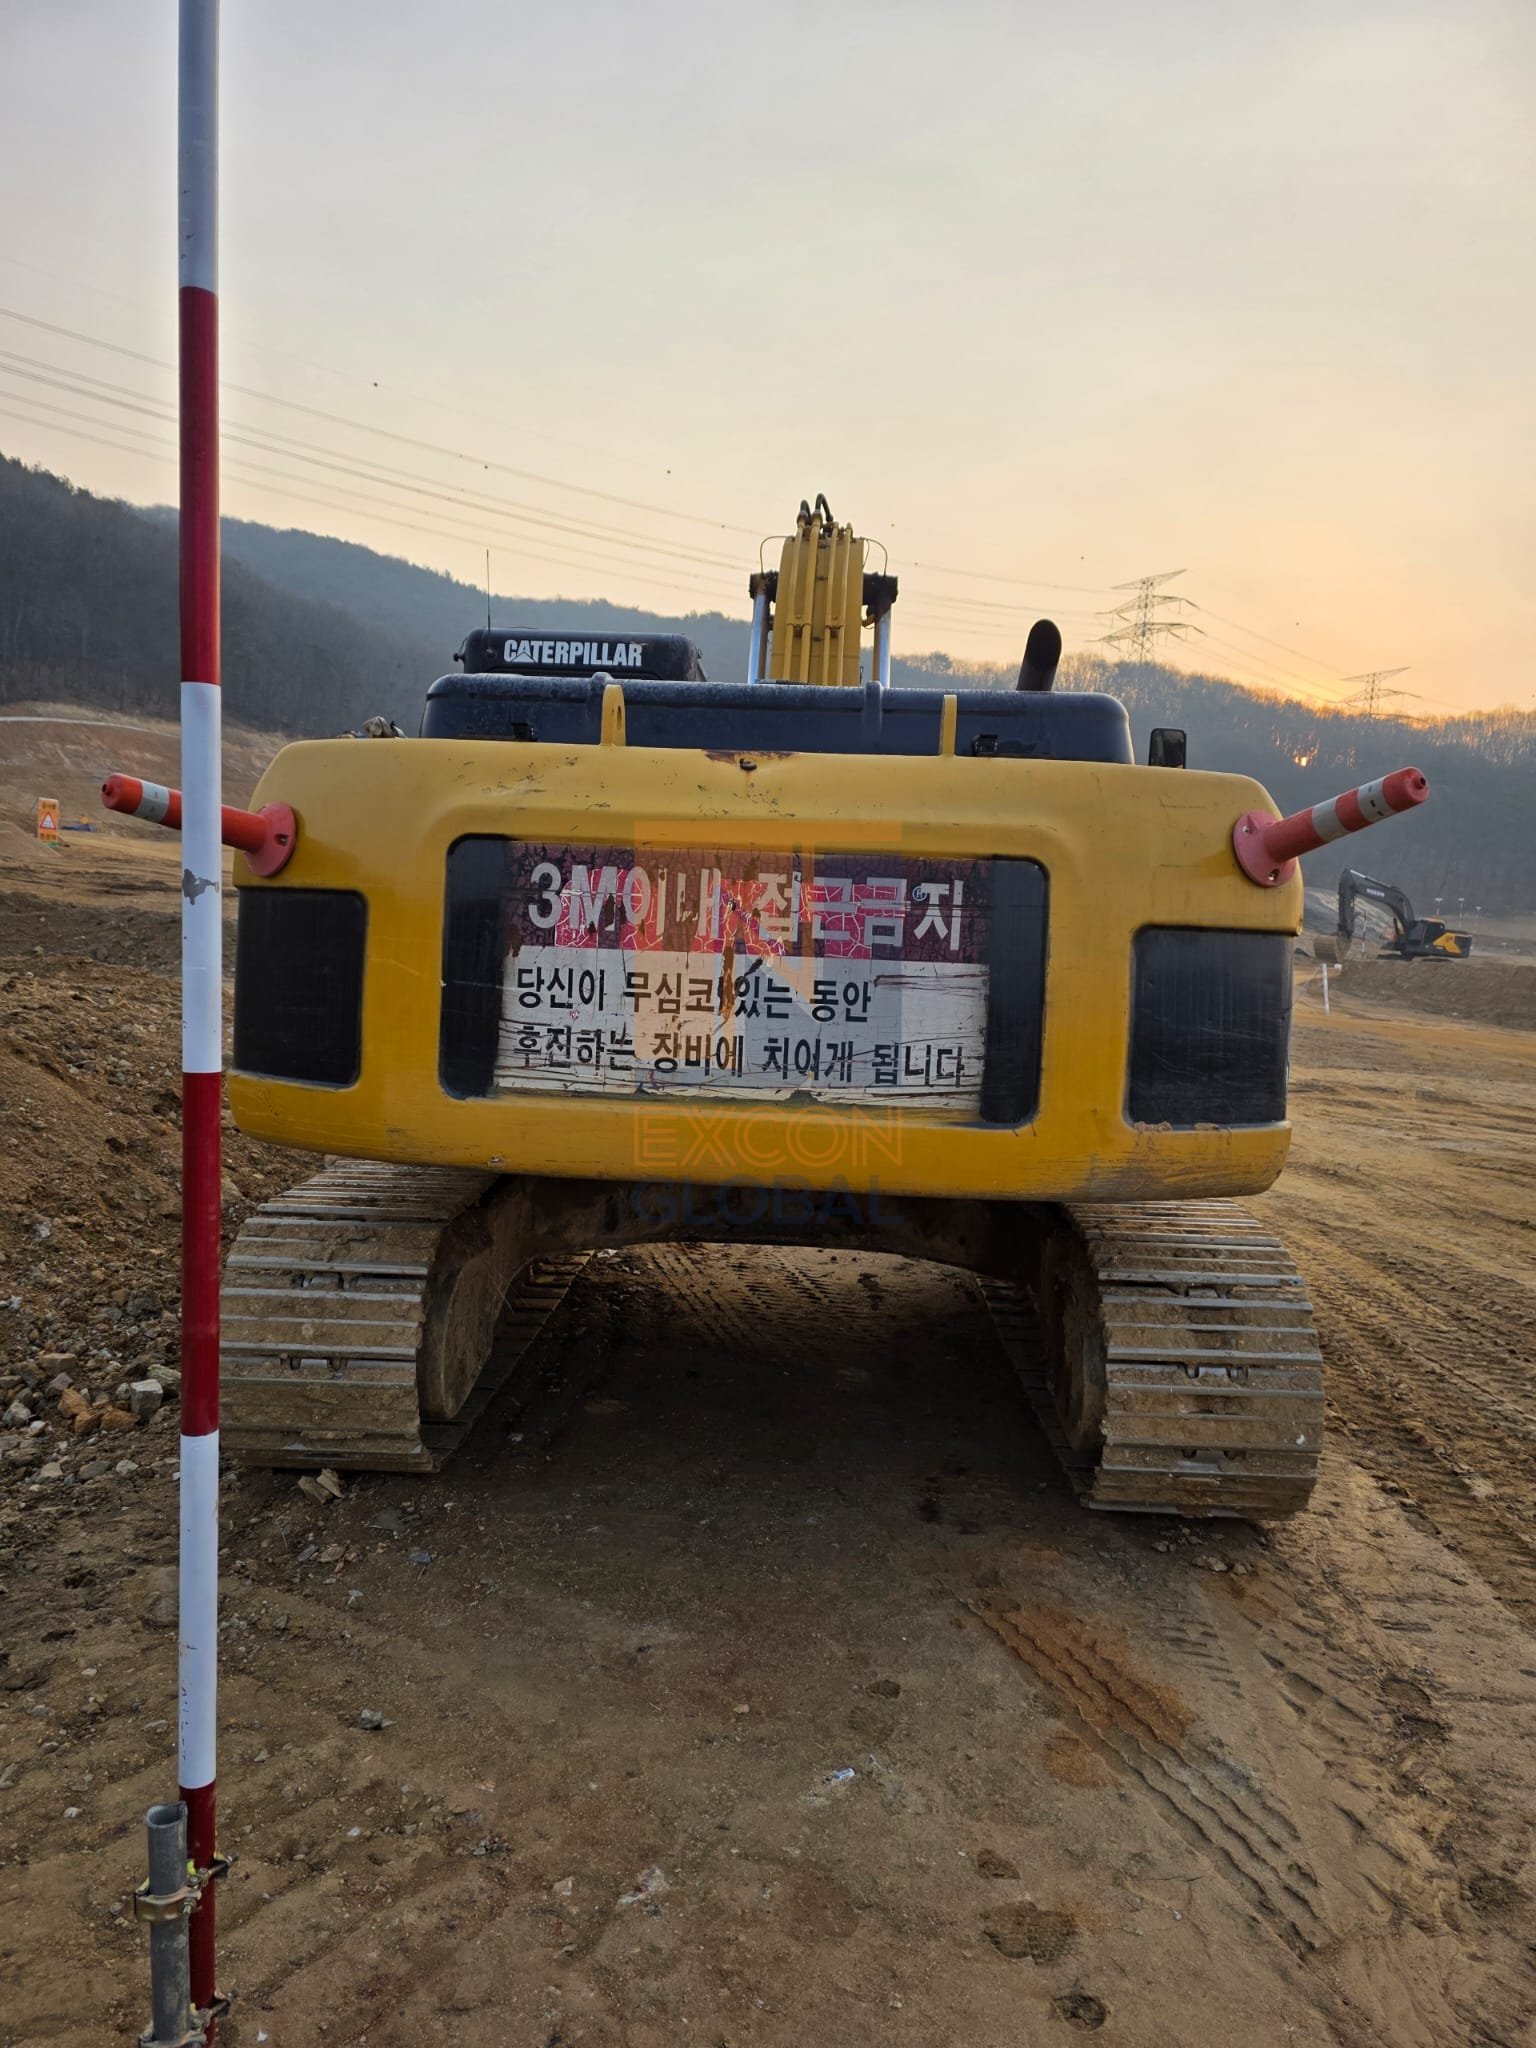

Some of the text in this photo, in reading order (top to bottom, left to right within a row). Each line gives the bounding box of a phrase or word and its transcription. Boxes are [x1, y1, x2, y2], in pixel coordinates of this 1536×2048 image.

[503, 639, 643, 668] CATERPILLAR
[758, 872, 964, 951] 접근금지
[517, 966, 872, 1023] 당신이 무심코 있는 동안
[513, 1025, 966, 1088] 후진하는 장비에 치이게 됩니다
